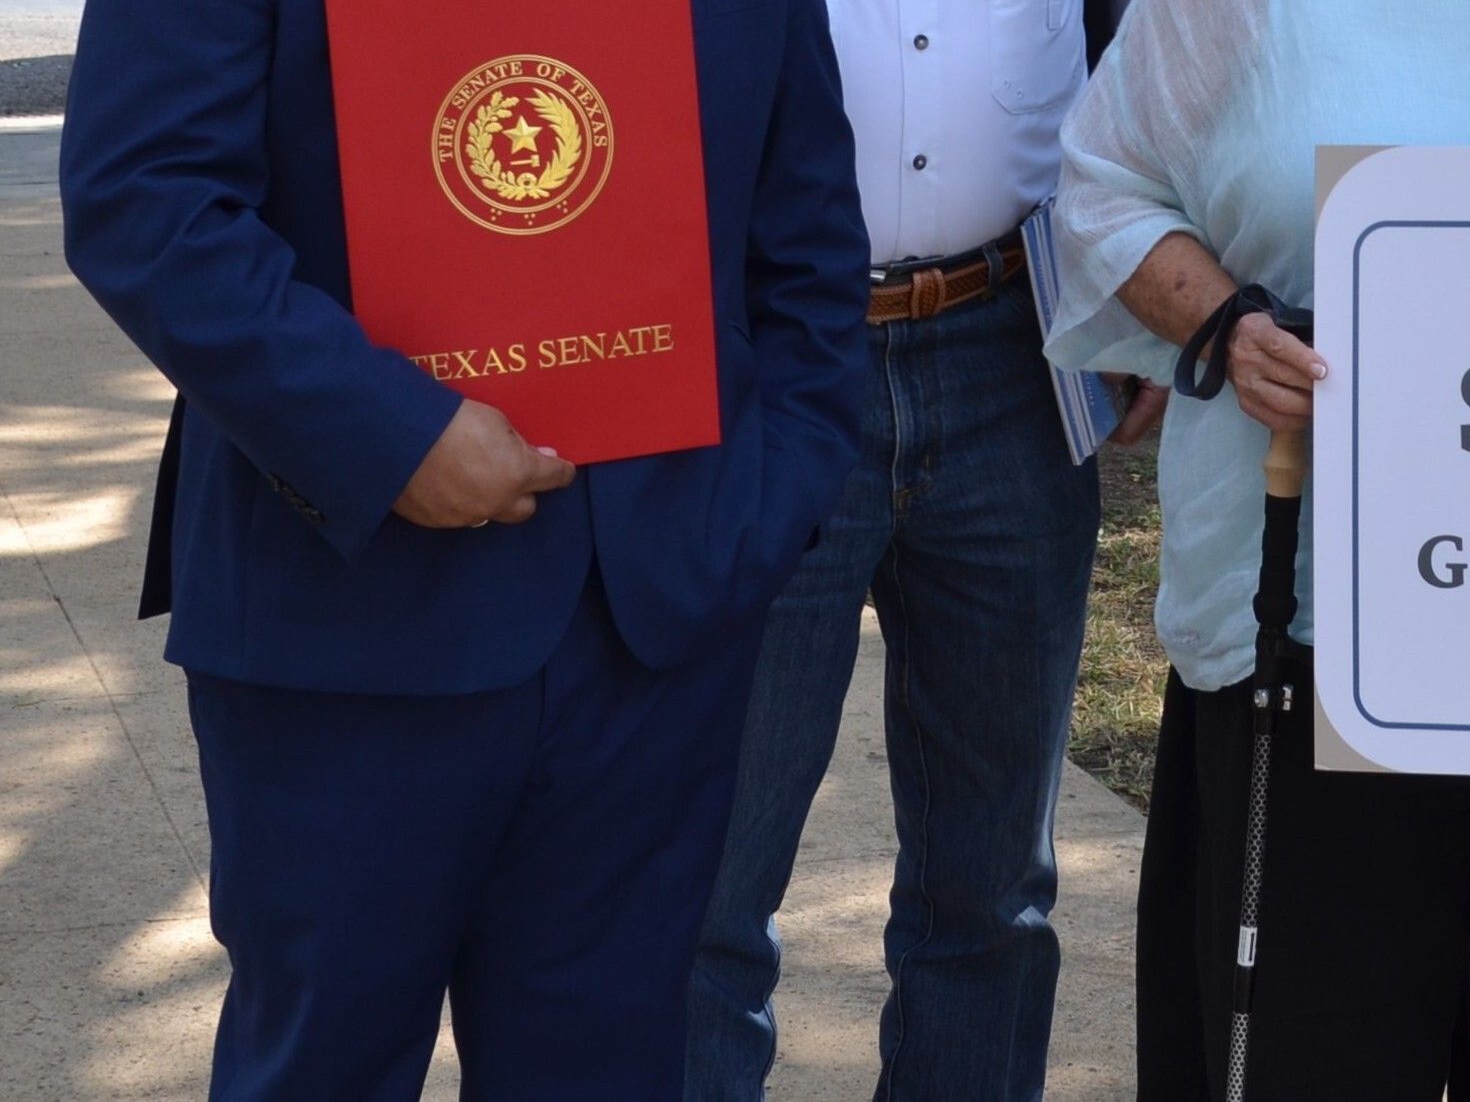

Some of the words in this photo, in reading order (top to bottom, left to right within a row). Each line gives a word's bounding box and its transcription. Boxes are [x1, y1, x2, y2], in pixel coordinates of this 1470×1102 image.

[439, 118, 456, 162] THE
[452, 61, 523, 110] SENATE
[536, 63, 567, 82] OF
[570, 80, 608, 147] TEXAS
[538, 324, 675, 368] SENATE
